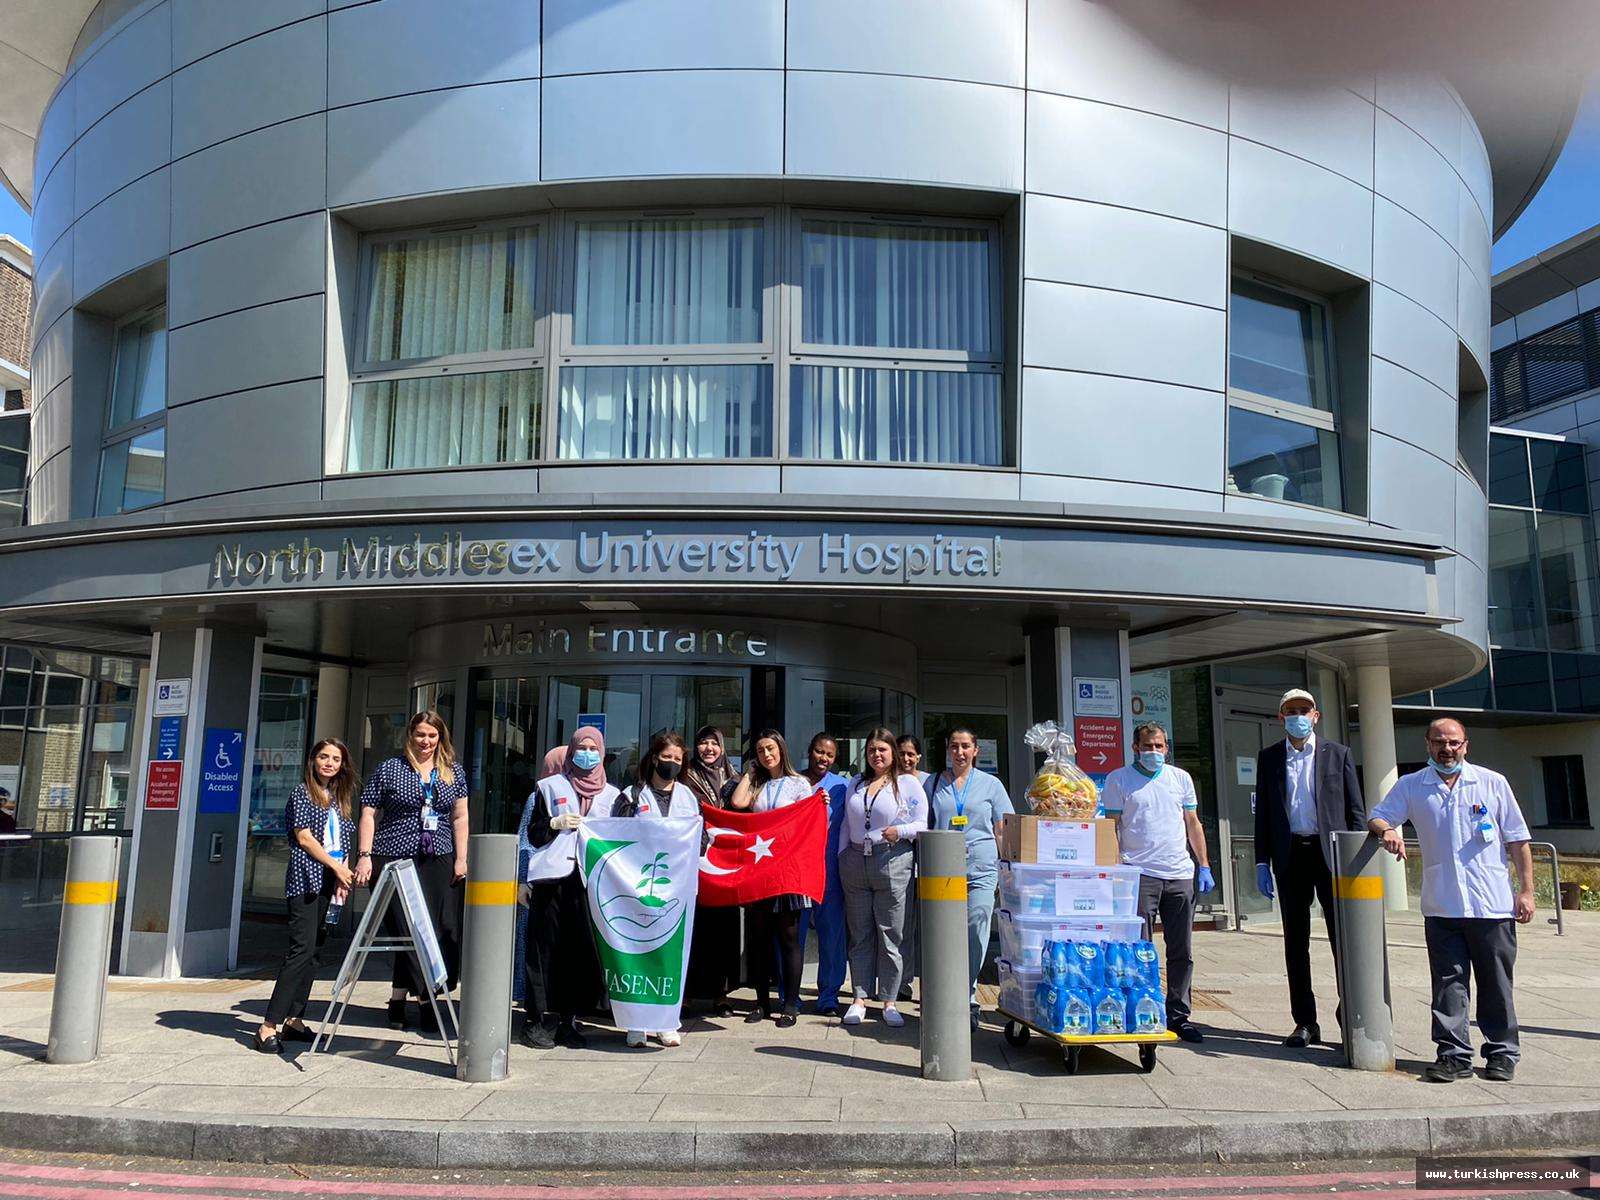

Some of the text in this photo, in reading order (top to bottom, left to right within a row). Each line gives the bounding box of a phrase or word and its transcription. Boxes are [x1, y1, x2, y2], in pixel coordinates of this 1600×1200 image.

[213, 529, 1001, 581] North Middlesex University Hospital
[482, 618, 768, 657] Main Entrance
[1079, 724, 1105, 732] Accident
[1082, 732, 1115, 741] Emergency
[1081, 740, 1117, 749] Department
[204, 772, 239, 781] Disabled
[207, 782, 234, 792] Access
